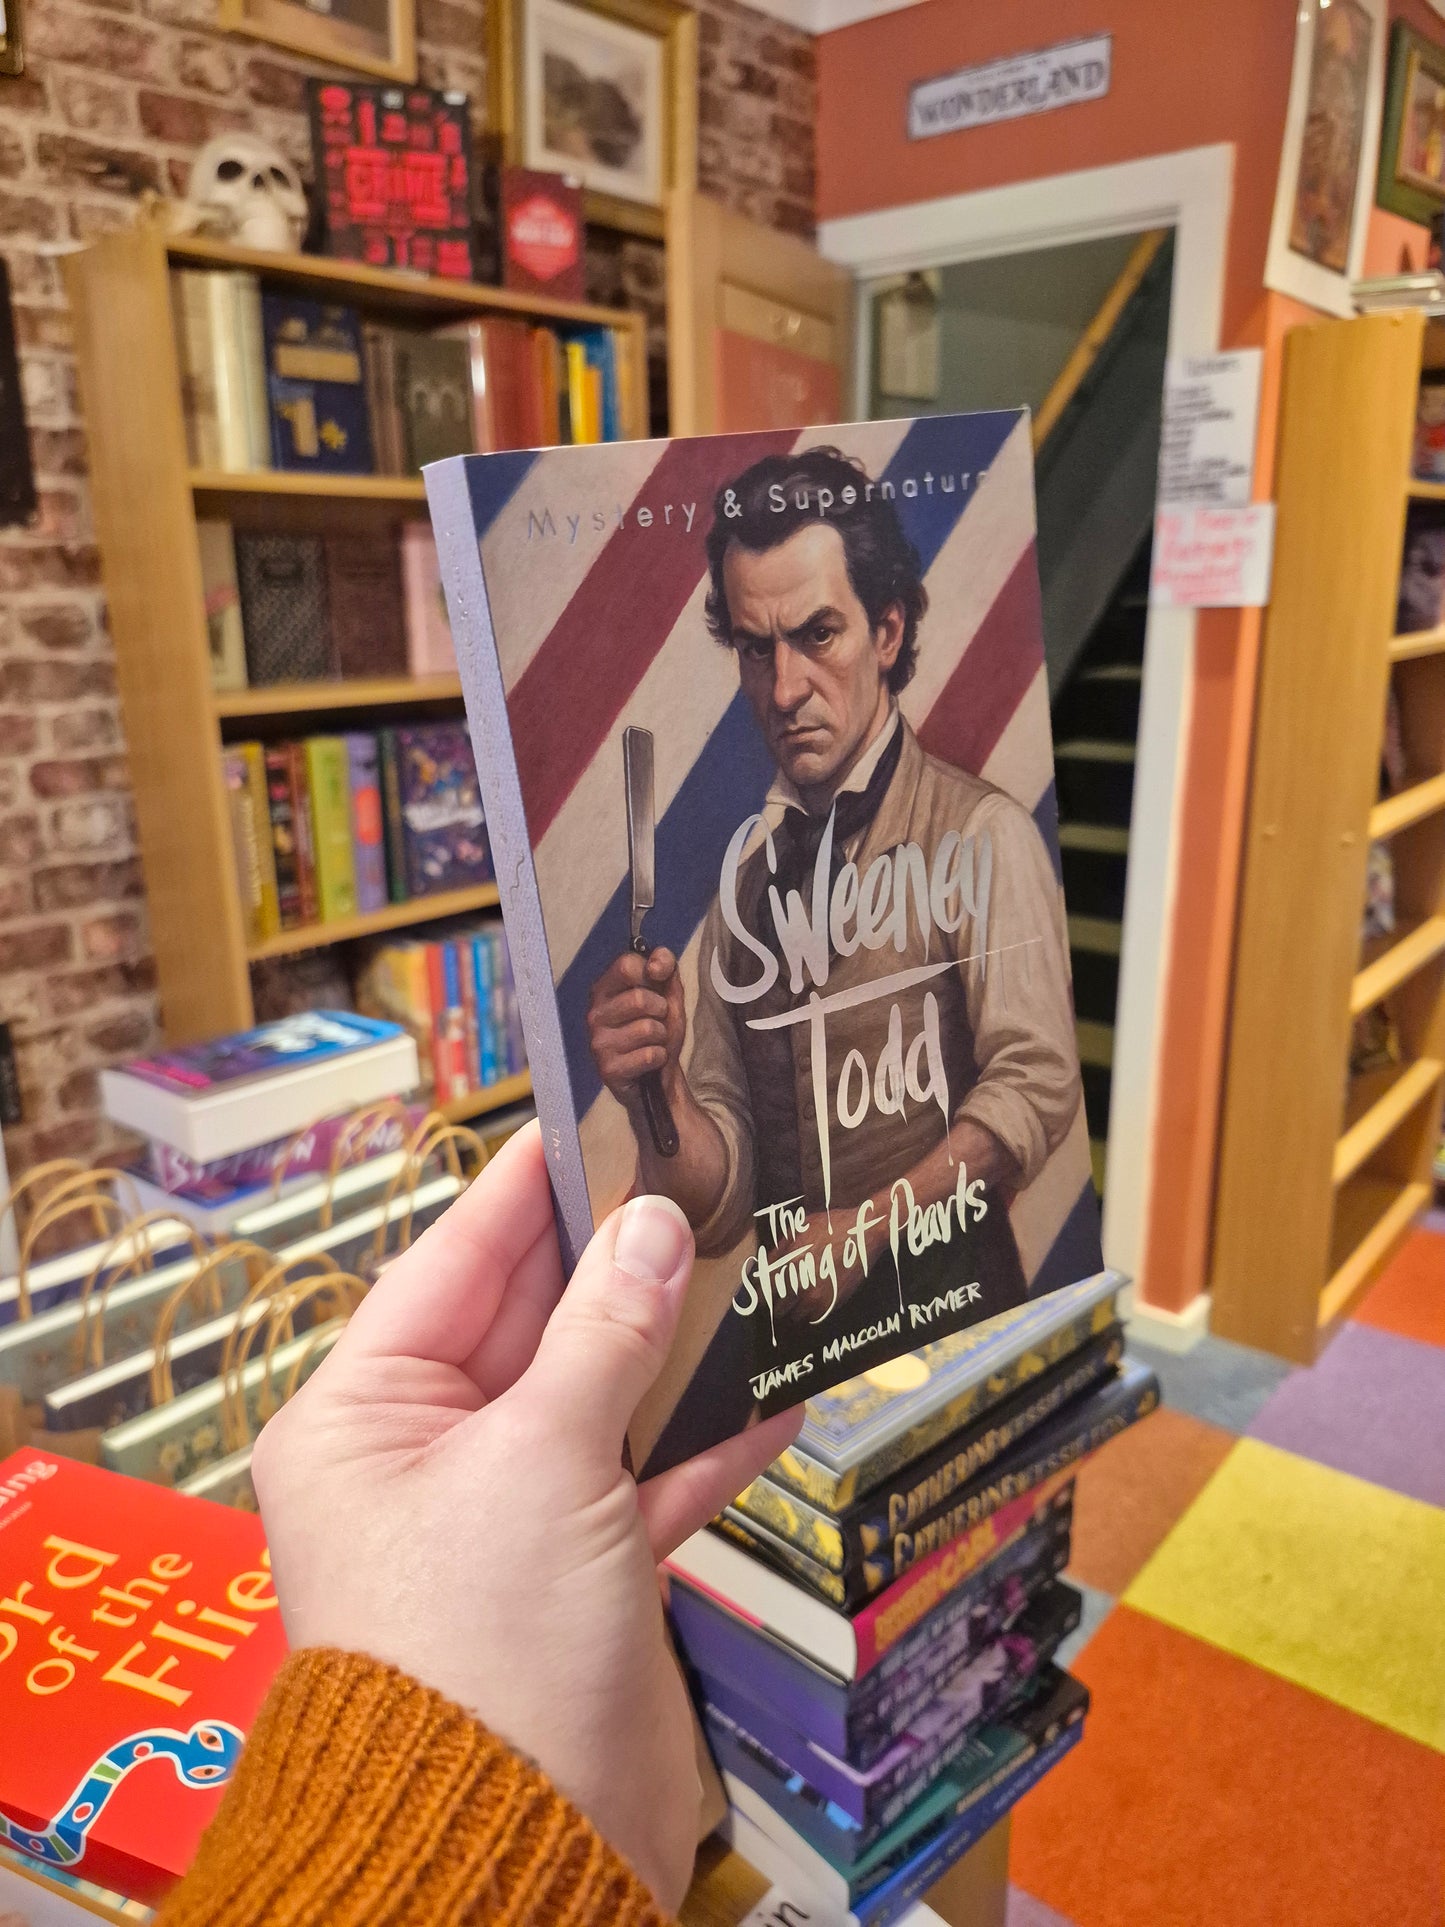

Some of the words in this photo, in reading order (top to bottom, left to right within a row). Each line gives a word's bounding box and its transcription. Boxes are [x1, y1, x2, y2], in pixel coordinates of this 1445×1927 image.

[526, 501, 698, 545] Mystery
[722, 485, 744, 519] &
[770, 470, 988, 517] Supernatur
[710, 799, 993, 1004] Sweeney
[745, 961, 957, 1212] Todd
[732, 1243, 838, 1340] String
[842, 1199, 888, 1278] of
[888, 1161, 989, 1275] Pearls
[753, 1194, 810, 1249] The
[749, 1353, 814, 1400] JAMES
[822, 1313, 901, 1364] MALCOLM
[907, 1281, 983, 1330] RYMER
[0, 1460, 59, 1508] ing
[26, 1625, 100, 1696] of
[90, 1553, 194, 1628] the
[101, 1546, 279, 1708] Flie
